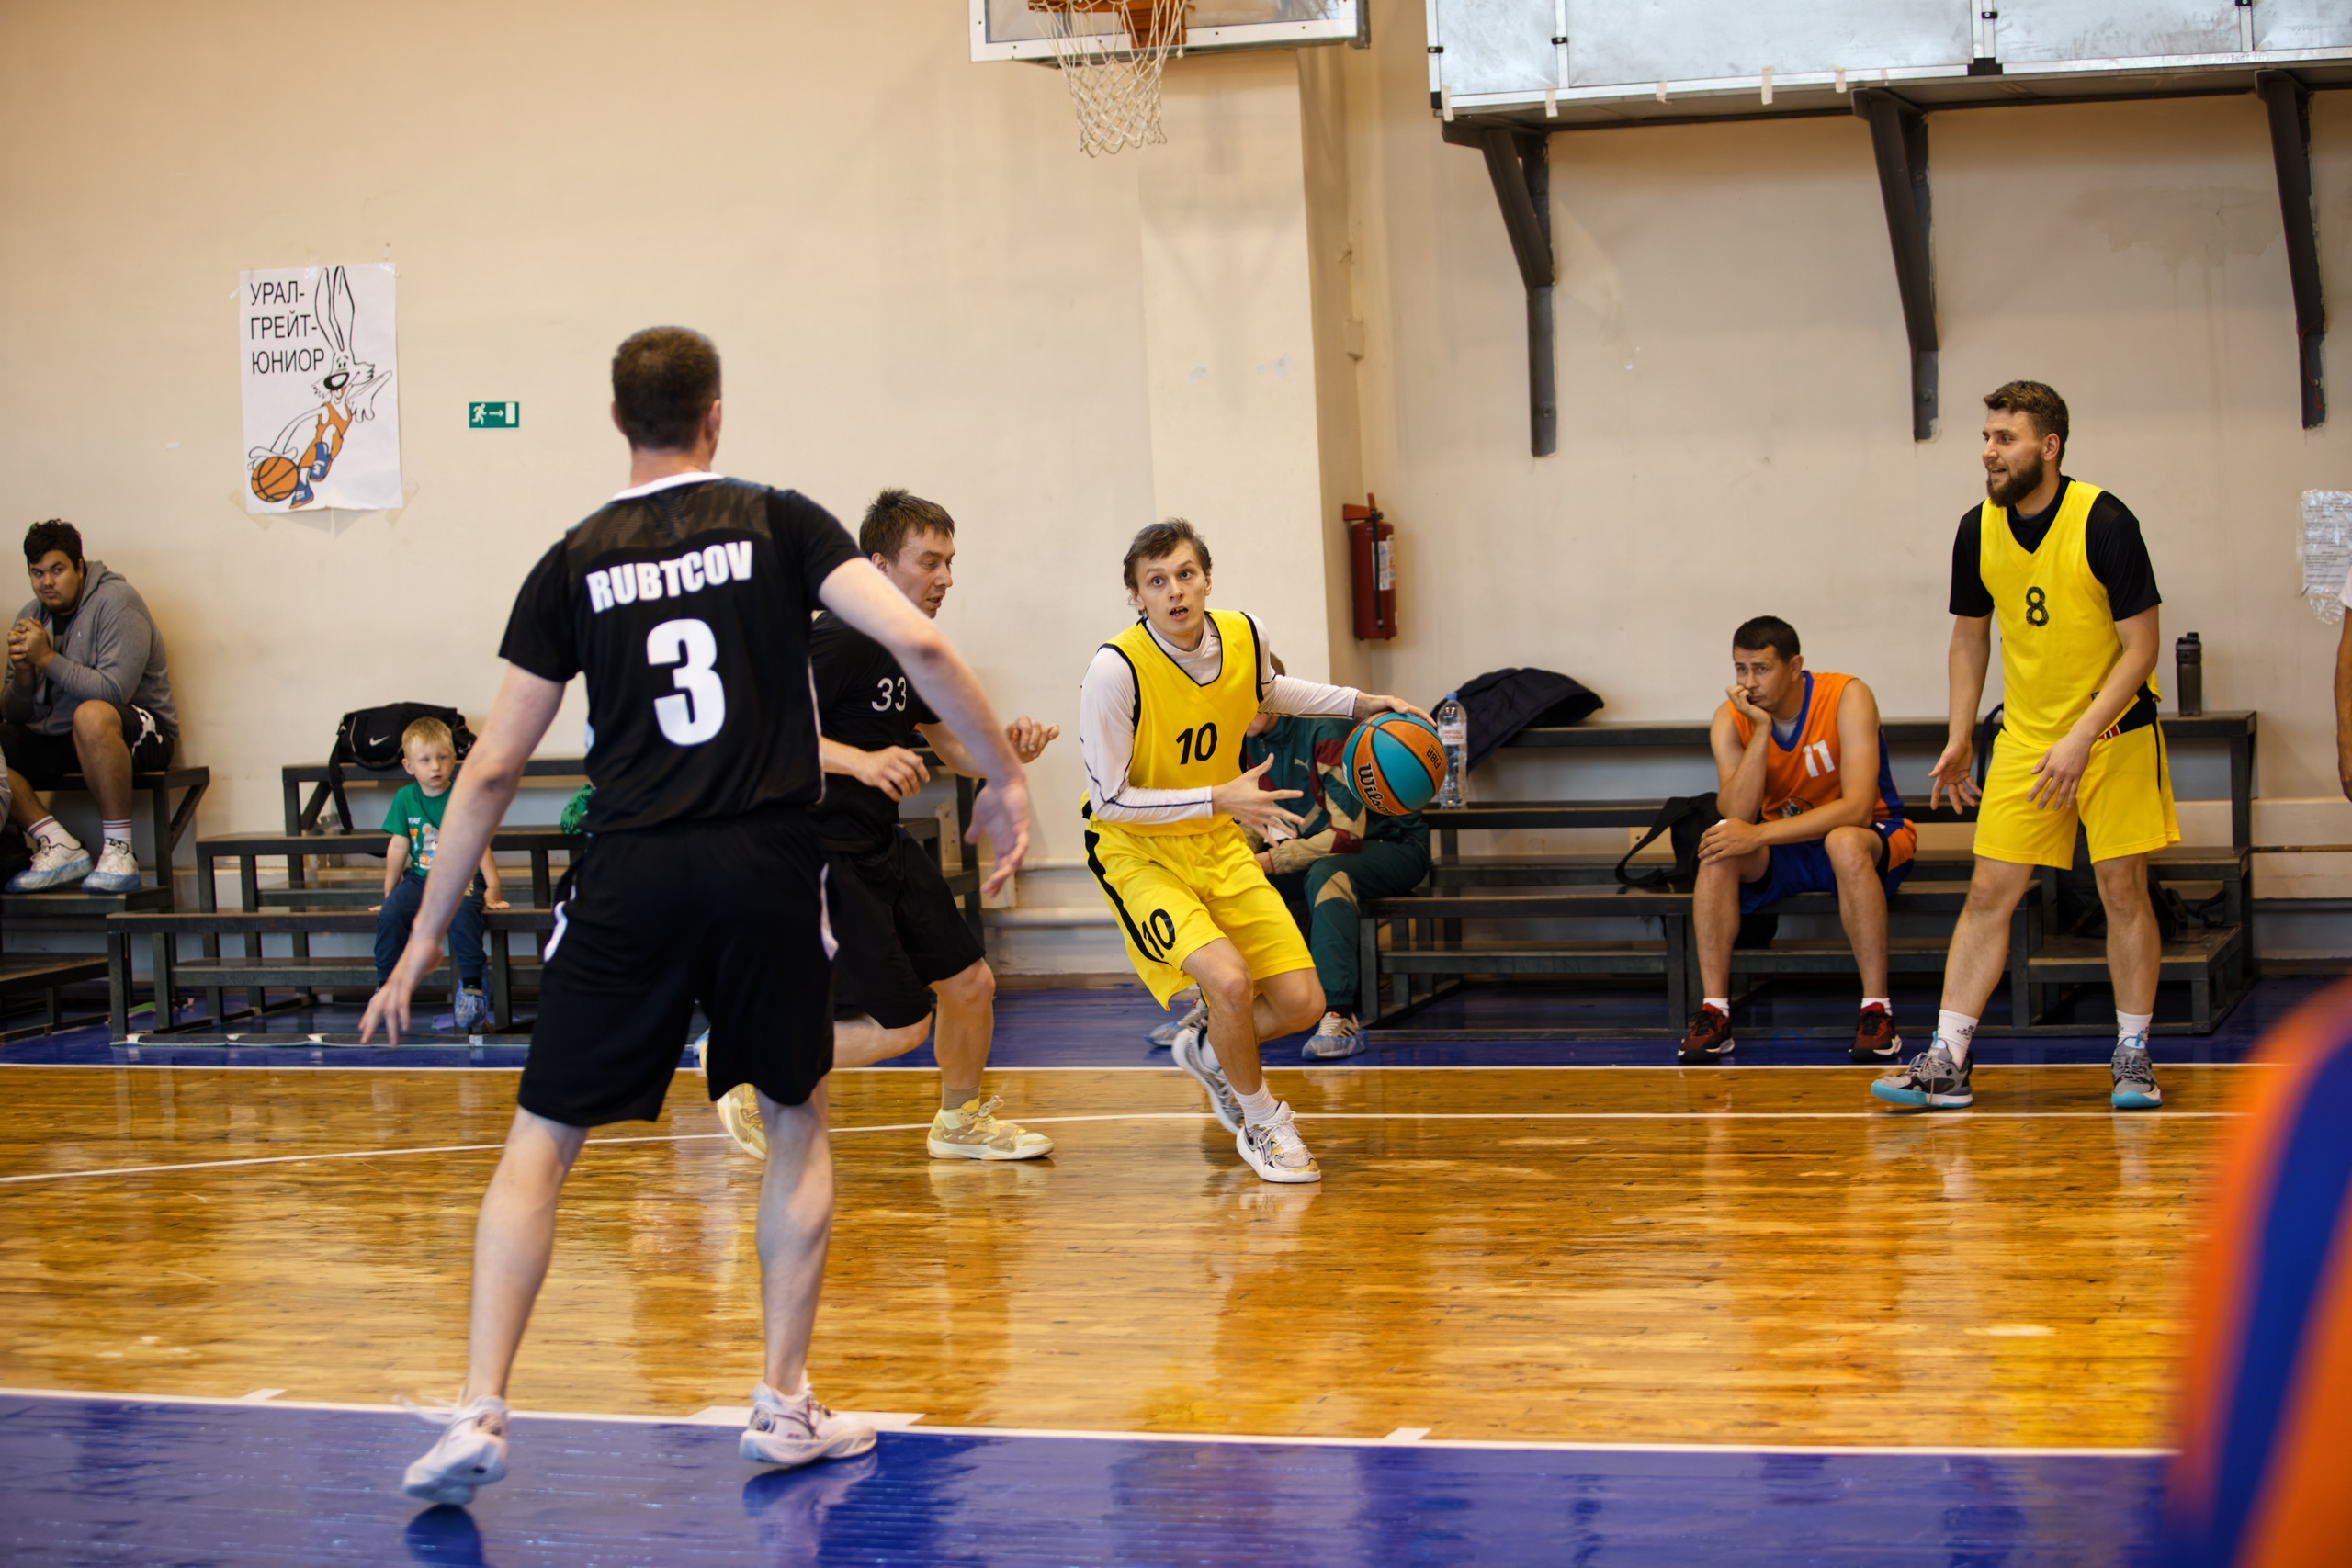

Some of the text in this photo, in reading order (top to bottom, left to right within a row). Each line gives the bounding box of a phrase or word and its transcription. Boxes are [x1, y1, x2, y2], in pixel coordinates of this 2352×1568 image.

[250, 280, 305, 306] УРАЛ-
[250, 310, 318, 340] ГРЕЙТ-
[252, 348, 325, 375] ЮНИОР
[586, 540, 752, 614] RUBTCOV
[2025, 585, 2050, 627] 8
[646, 618, 726, 746] 3
[871, 676, 907, 712] 33
[1176, 722, 1218, 765] 10
[1426, 747, 1442, 770] FIBA
[1802, 739, 1836, 778] 11
[1357, 761, 1396, 816] Wilso
[1141, 908, 1176, 960] 10
